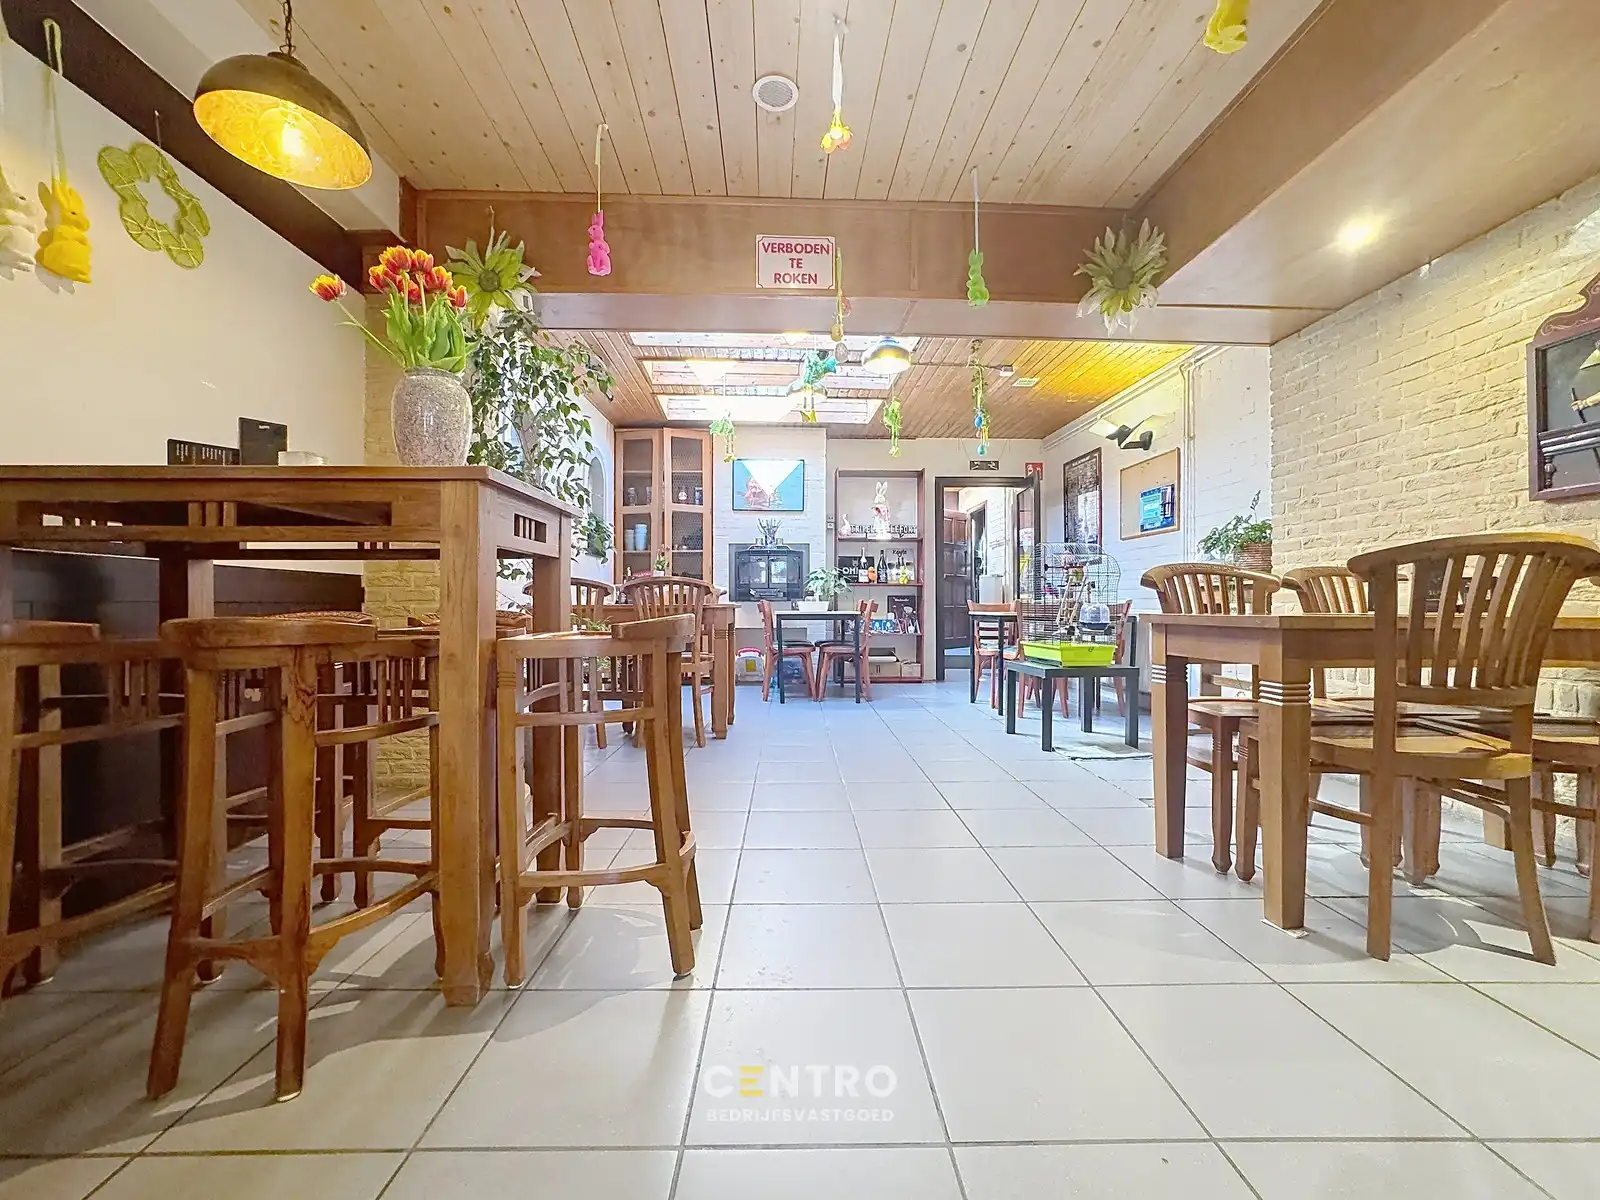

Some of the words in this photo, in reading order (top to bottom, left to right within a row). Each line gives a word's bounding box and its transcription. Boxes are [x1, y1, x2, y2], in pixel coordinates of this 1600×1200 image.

[761, 242, 830, 255] VERBODEN
[788, 257, 803, 269] TE
[773, 272, 818, 285] ROKEN
